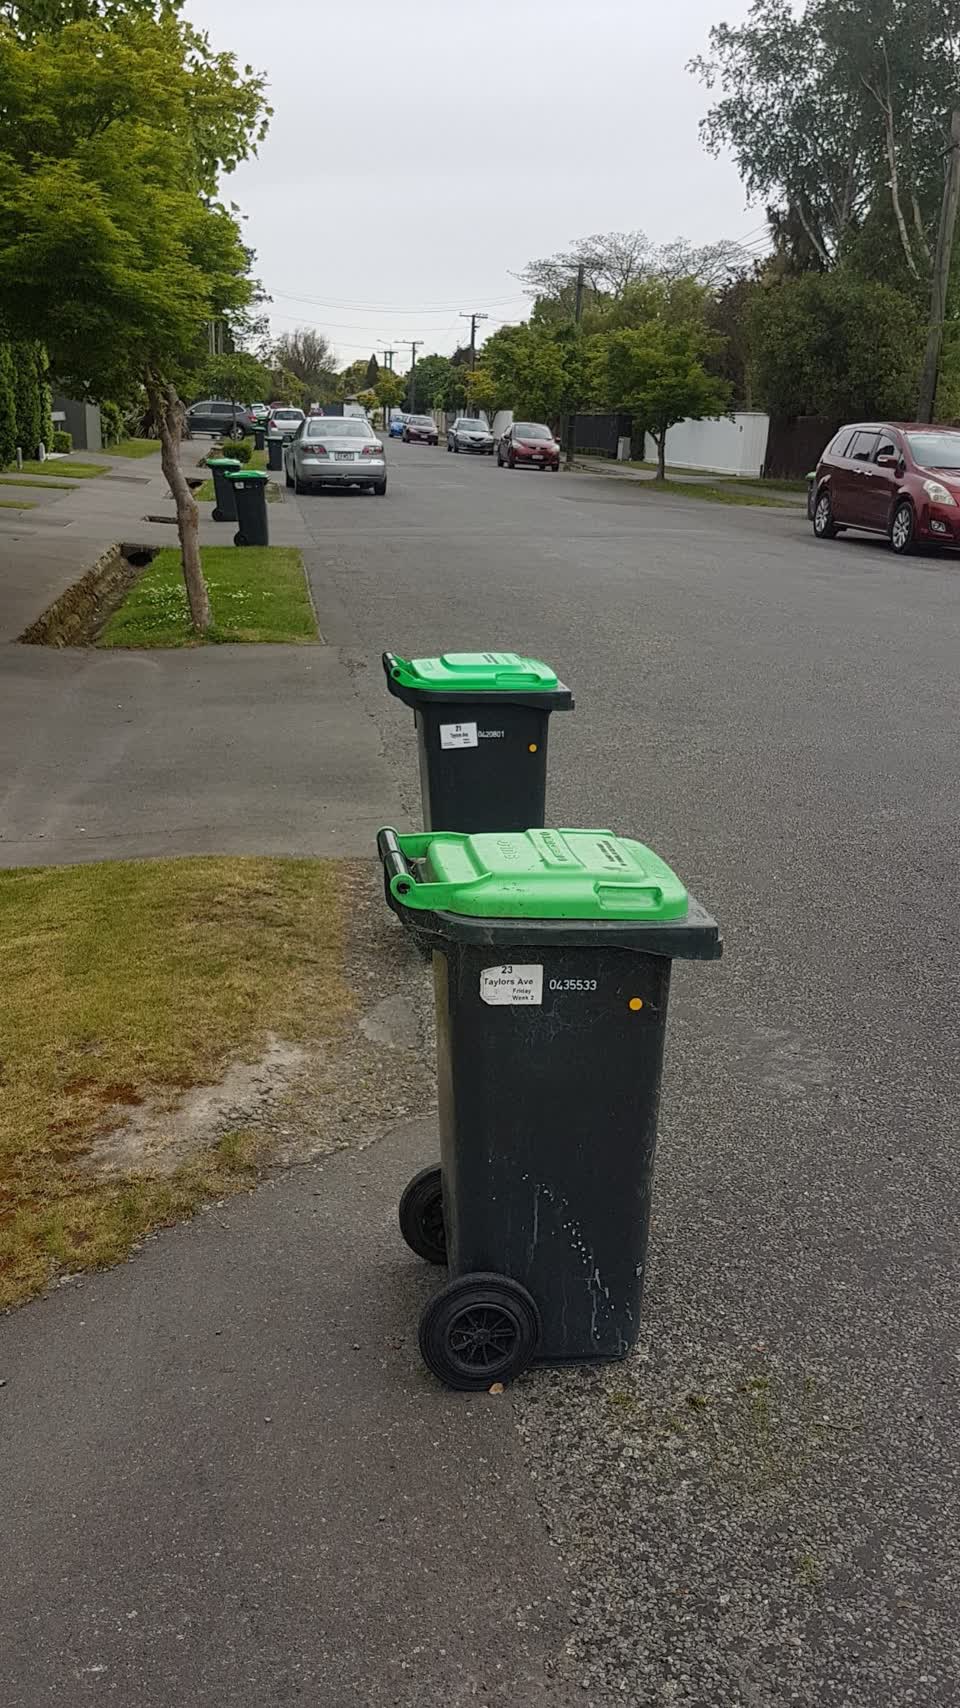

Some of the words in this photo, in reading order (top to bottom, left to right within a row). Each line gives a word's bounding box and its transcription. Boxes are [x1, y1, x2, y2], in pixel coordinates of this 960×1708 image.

[501, 965, 513, 974] 23
[484, 978, 515, 987] Taylors
[549, 979, 597, 990] 0435533
